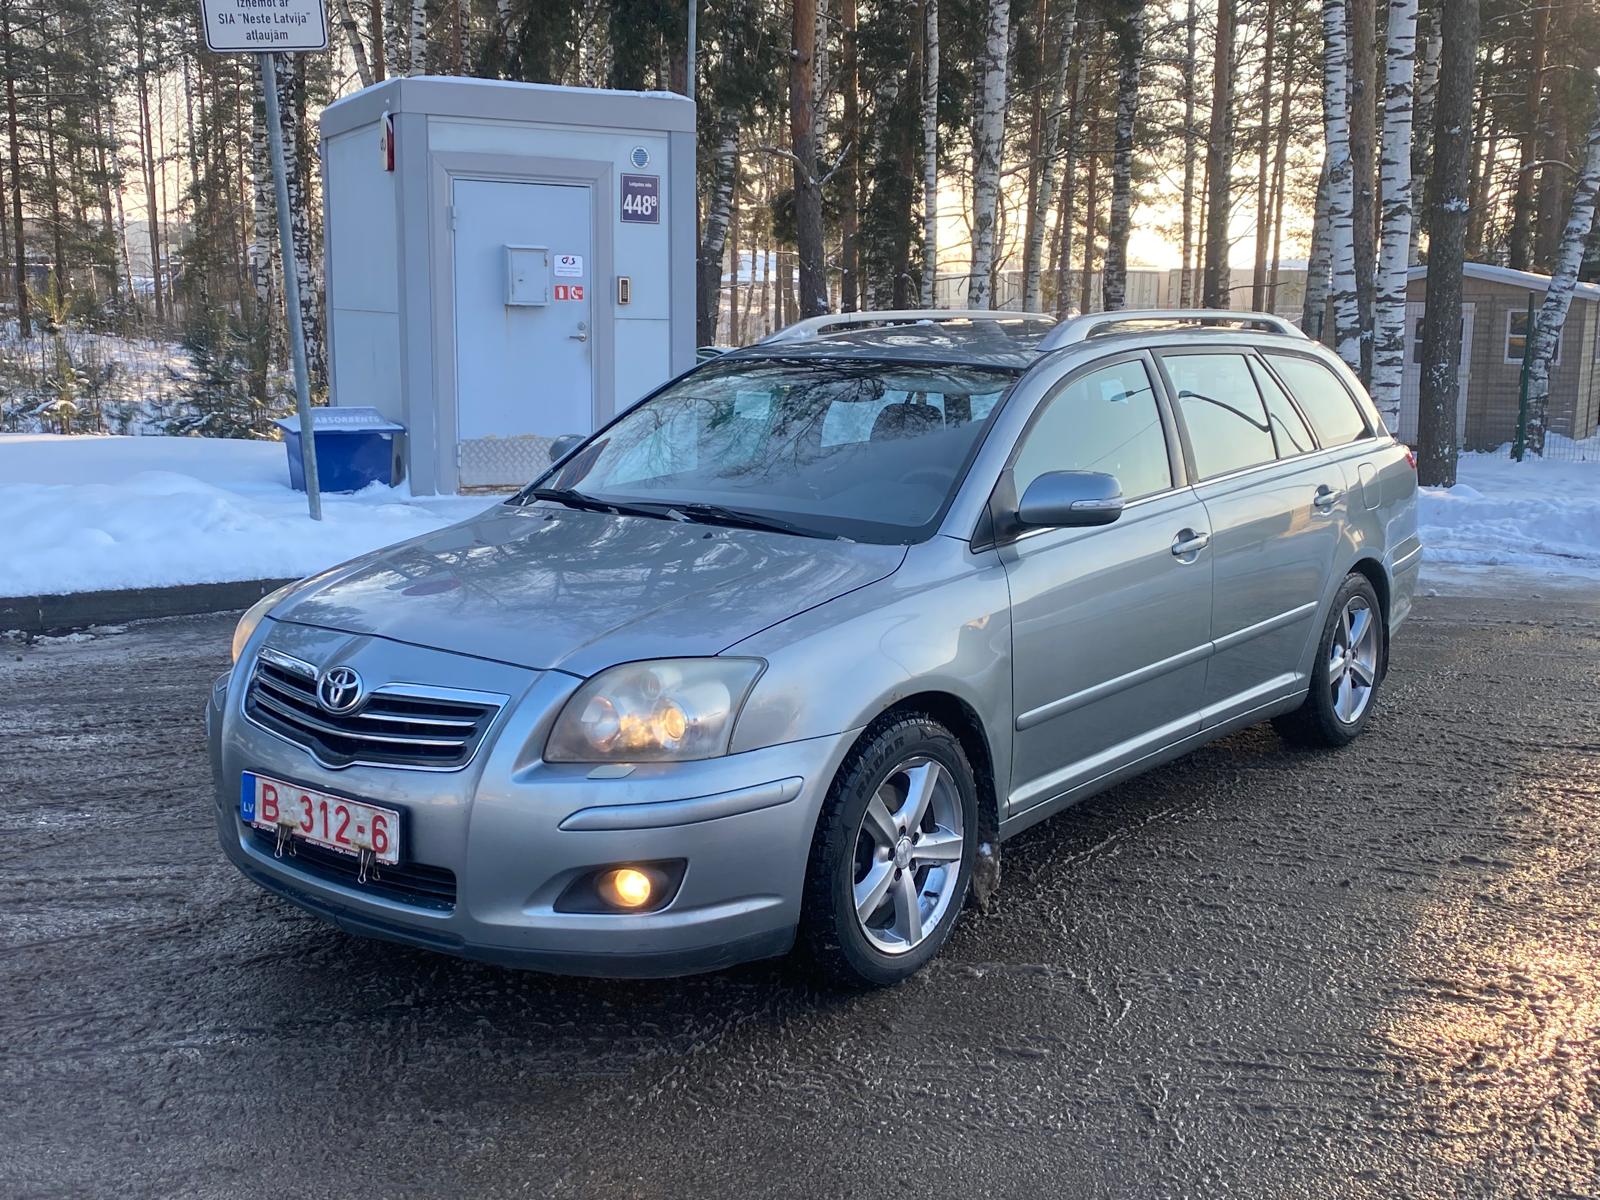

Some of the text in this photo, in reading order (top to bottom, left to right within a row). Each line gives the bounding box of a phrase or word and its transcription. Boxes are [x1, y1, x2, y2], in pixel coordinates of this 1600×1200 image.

[218, 13, 236, 25] SIA
[246, 29, 289, 43] atļaujām
[243, 801, 254, 813] LV
[262, 783, 279, 822] B
[300, 795, 388, 854] 312-6
